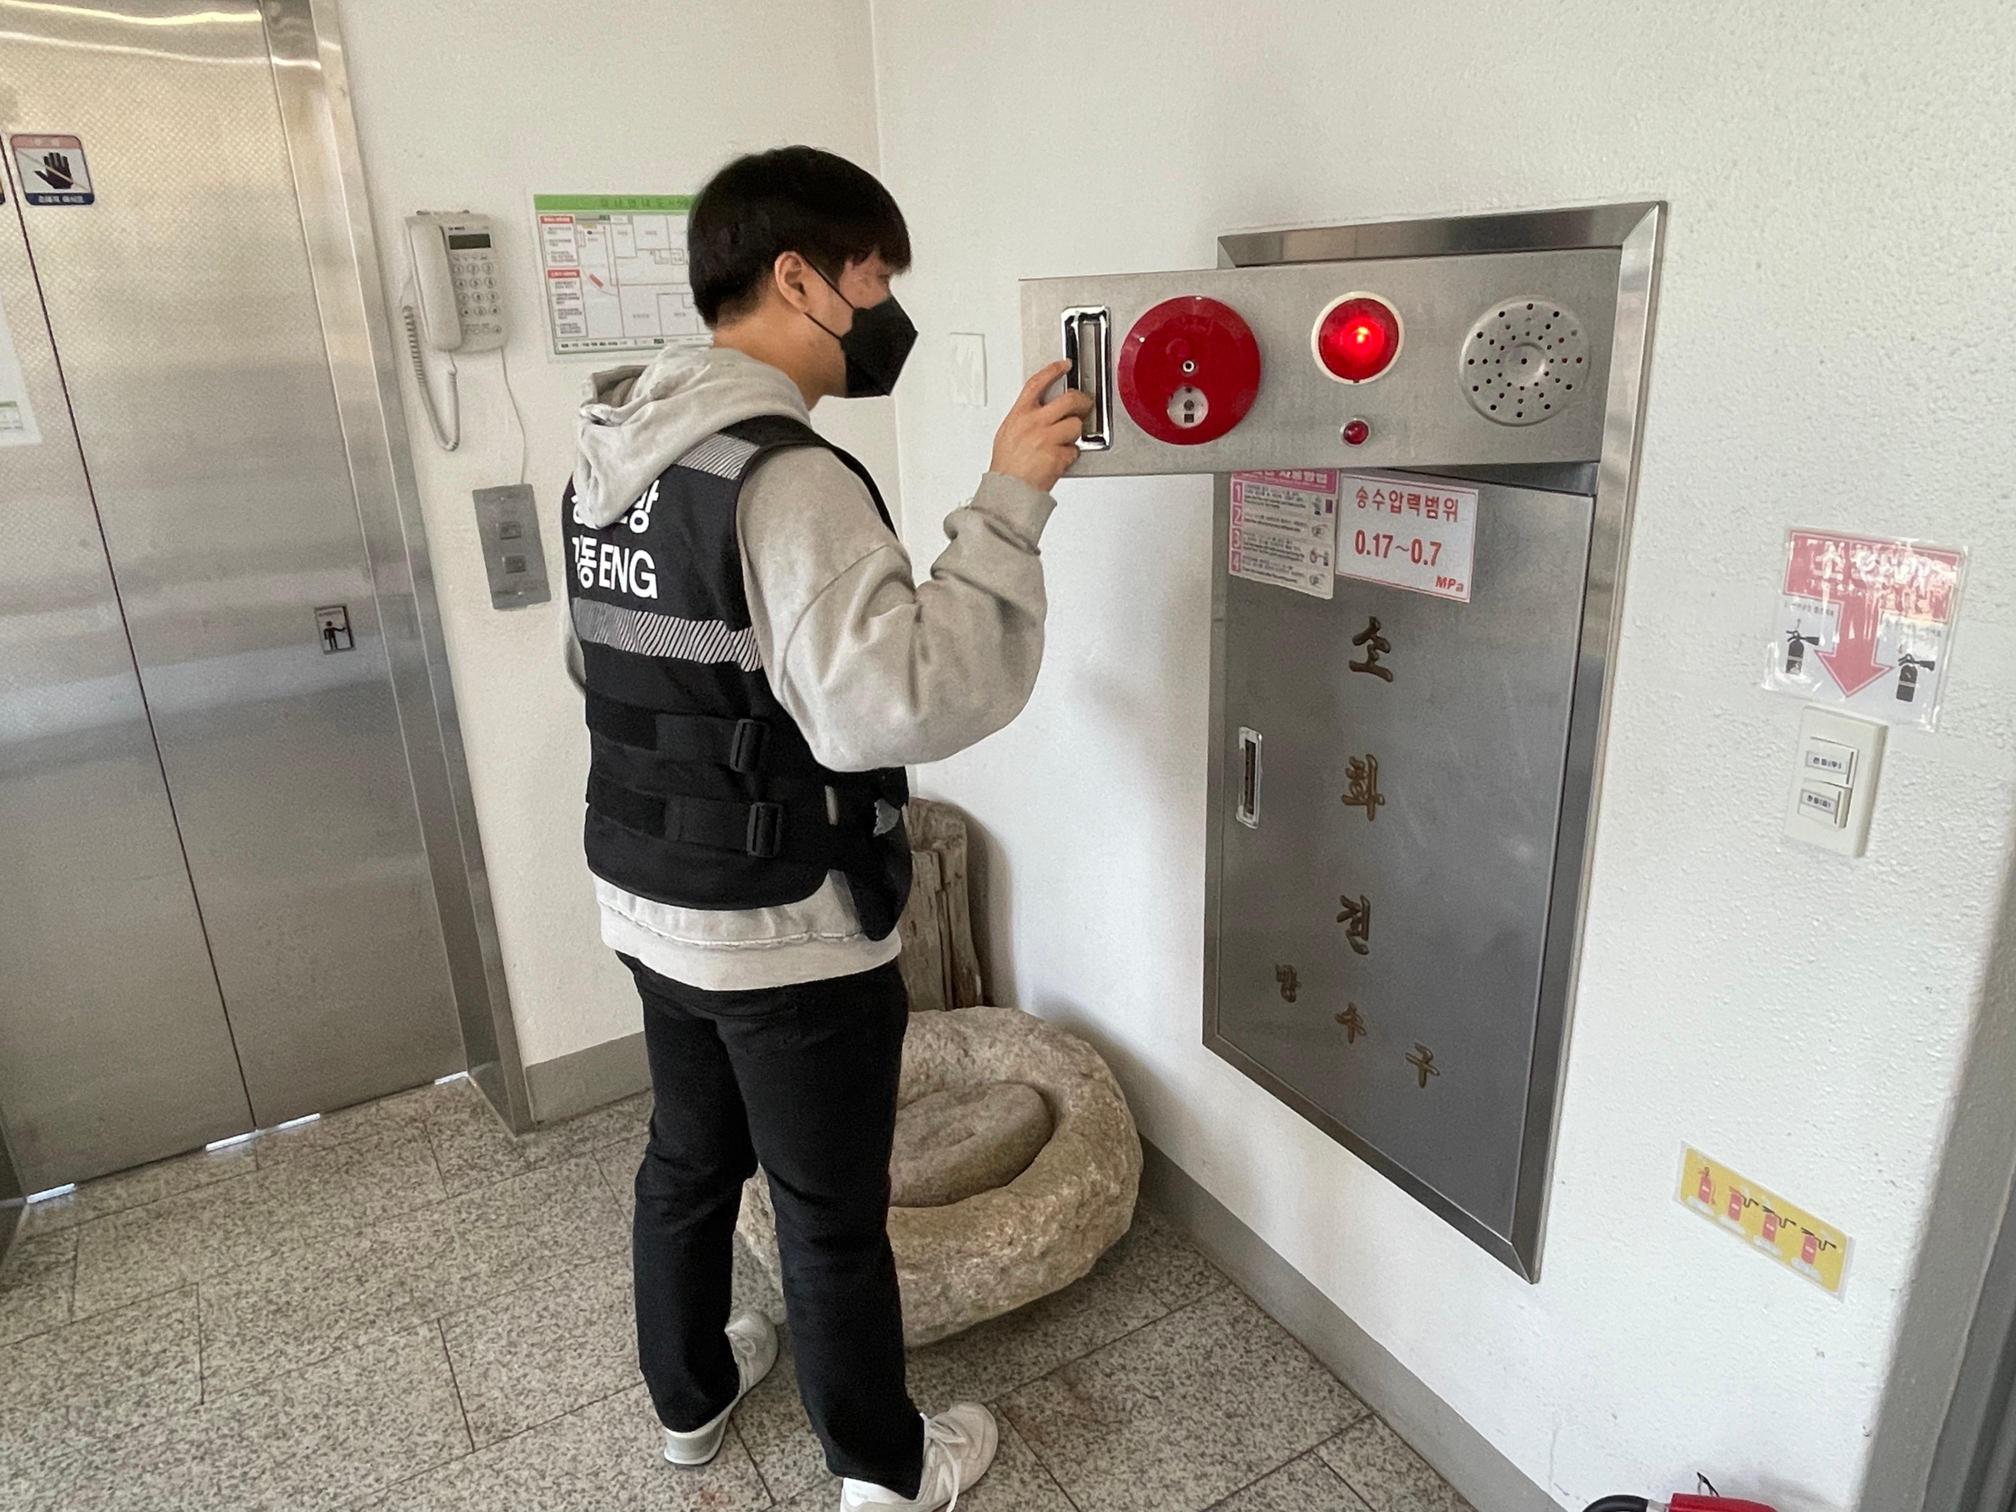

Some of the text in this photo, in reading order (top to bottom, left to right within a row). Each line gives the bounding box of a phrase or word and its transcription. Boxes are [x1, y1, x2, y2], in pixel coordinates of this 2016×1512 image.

[1355, 486, 1459, 522] 송수압력범위
[1355, 529, 1442, 567] 0.17~0.7
[1435, 575, 1465, 592] MPa
